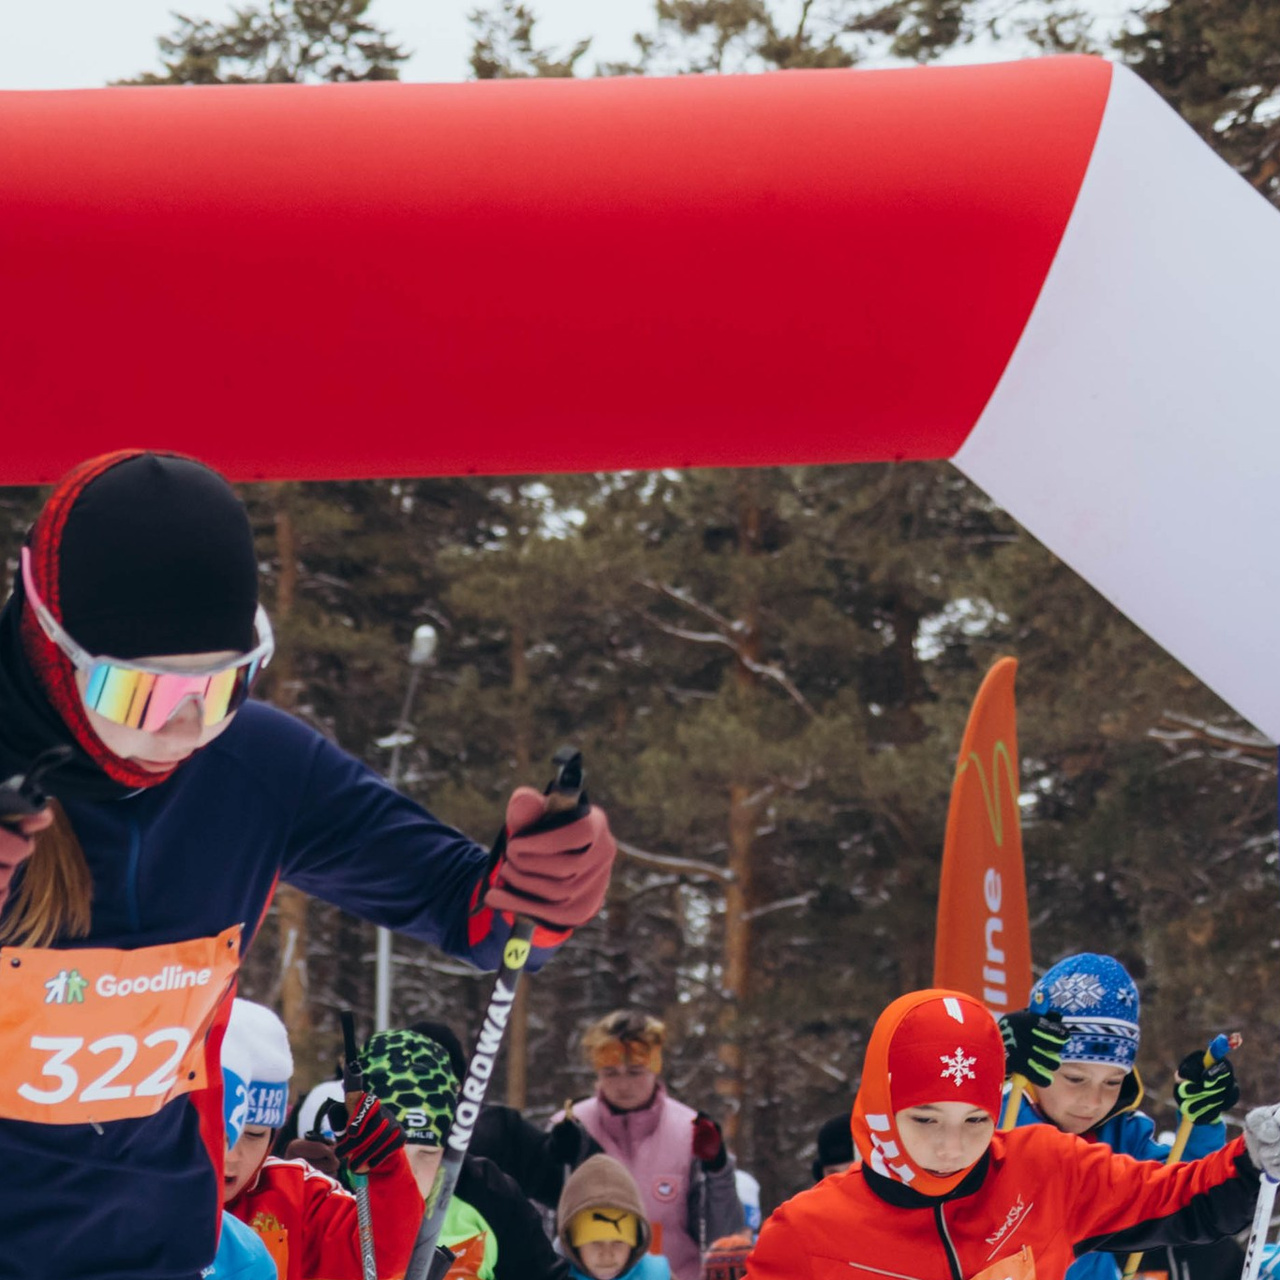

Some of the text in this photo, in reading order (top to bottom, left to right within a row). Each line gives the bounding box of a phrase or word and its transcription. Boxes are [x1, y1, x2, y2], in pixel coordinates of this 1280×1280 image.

[95, 964, 212, 998] Goodline
[983, 867, 1008, 1018] line
[17, 1026, 192, 1105] 322
[448, 977, 516, 1152] NORDWAY
